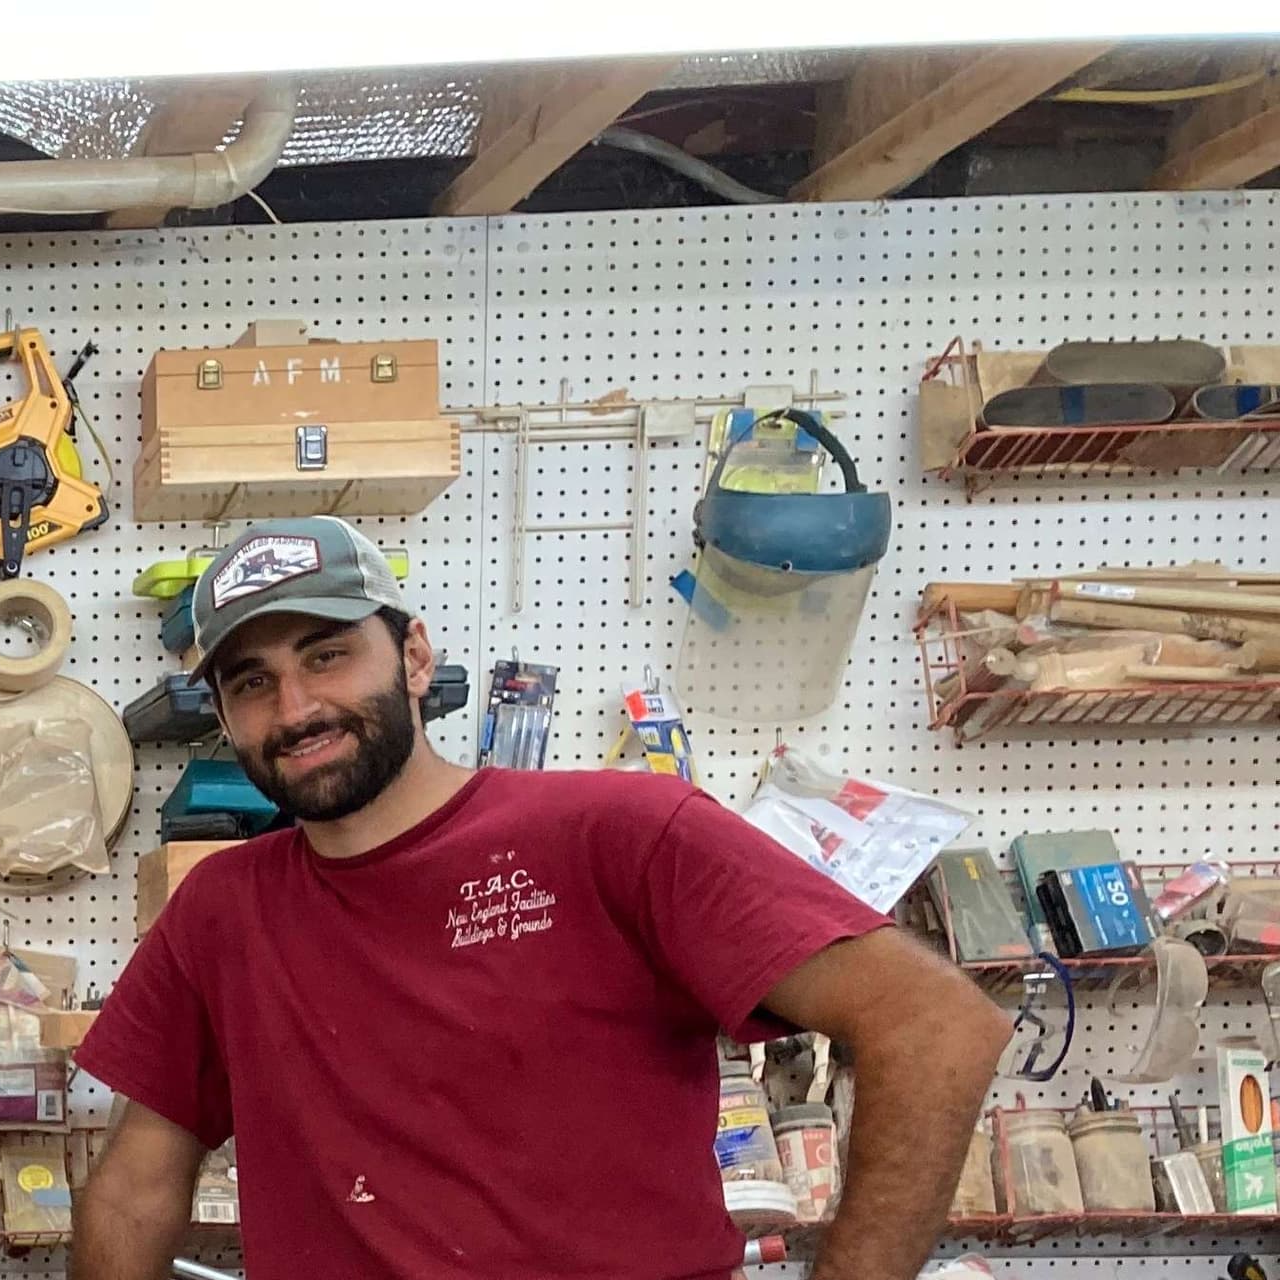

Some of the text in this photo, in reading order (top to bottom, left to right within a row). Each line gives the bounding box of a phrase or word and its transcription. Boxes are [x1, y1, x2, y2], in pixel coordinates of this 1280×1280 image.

[253, 356, 340, 386] A F M
[460, 869, 534, 901] T.A.C.
[446, 888, 556, 929] New England Facilities
[452, 909, 553, 948] Buildings & Grounds
